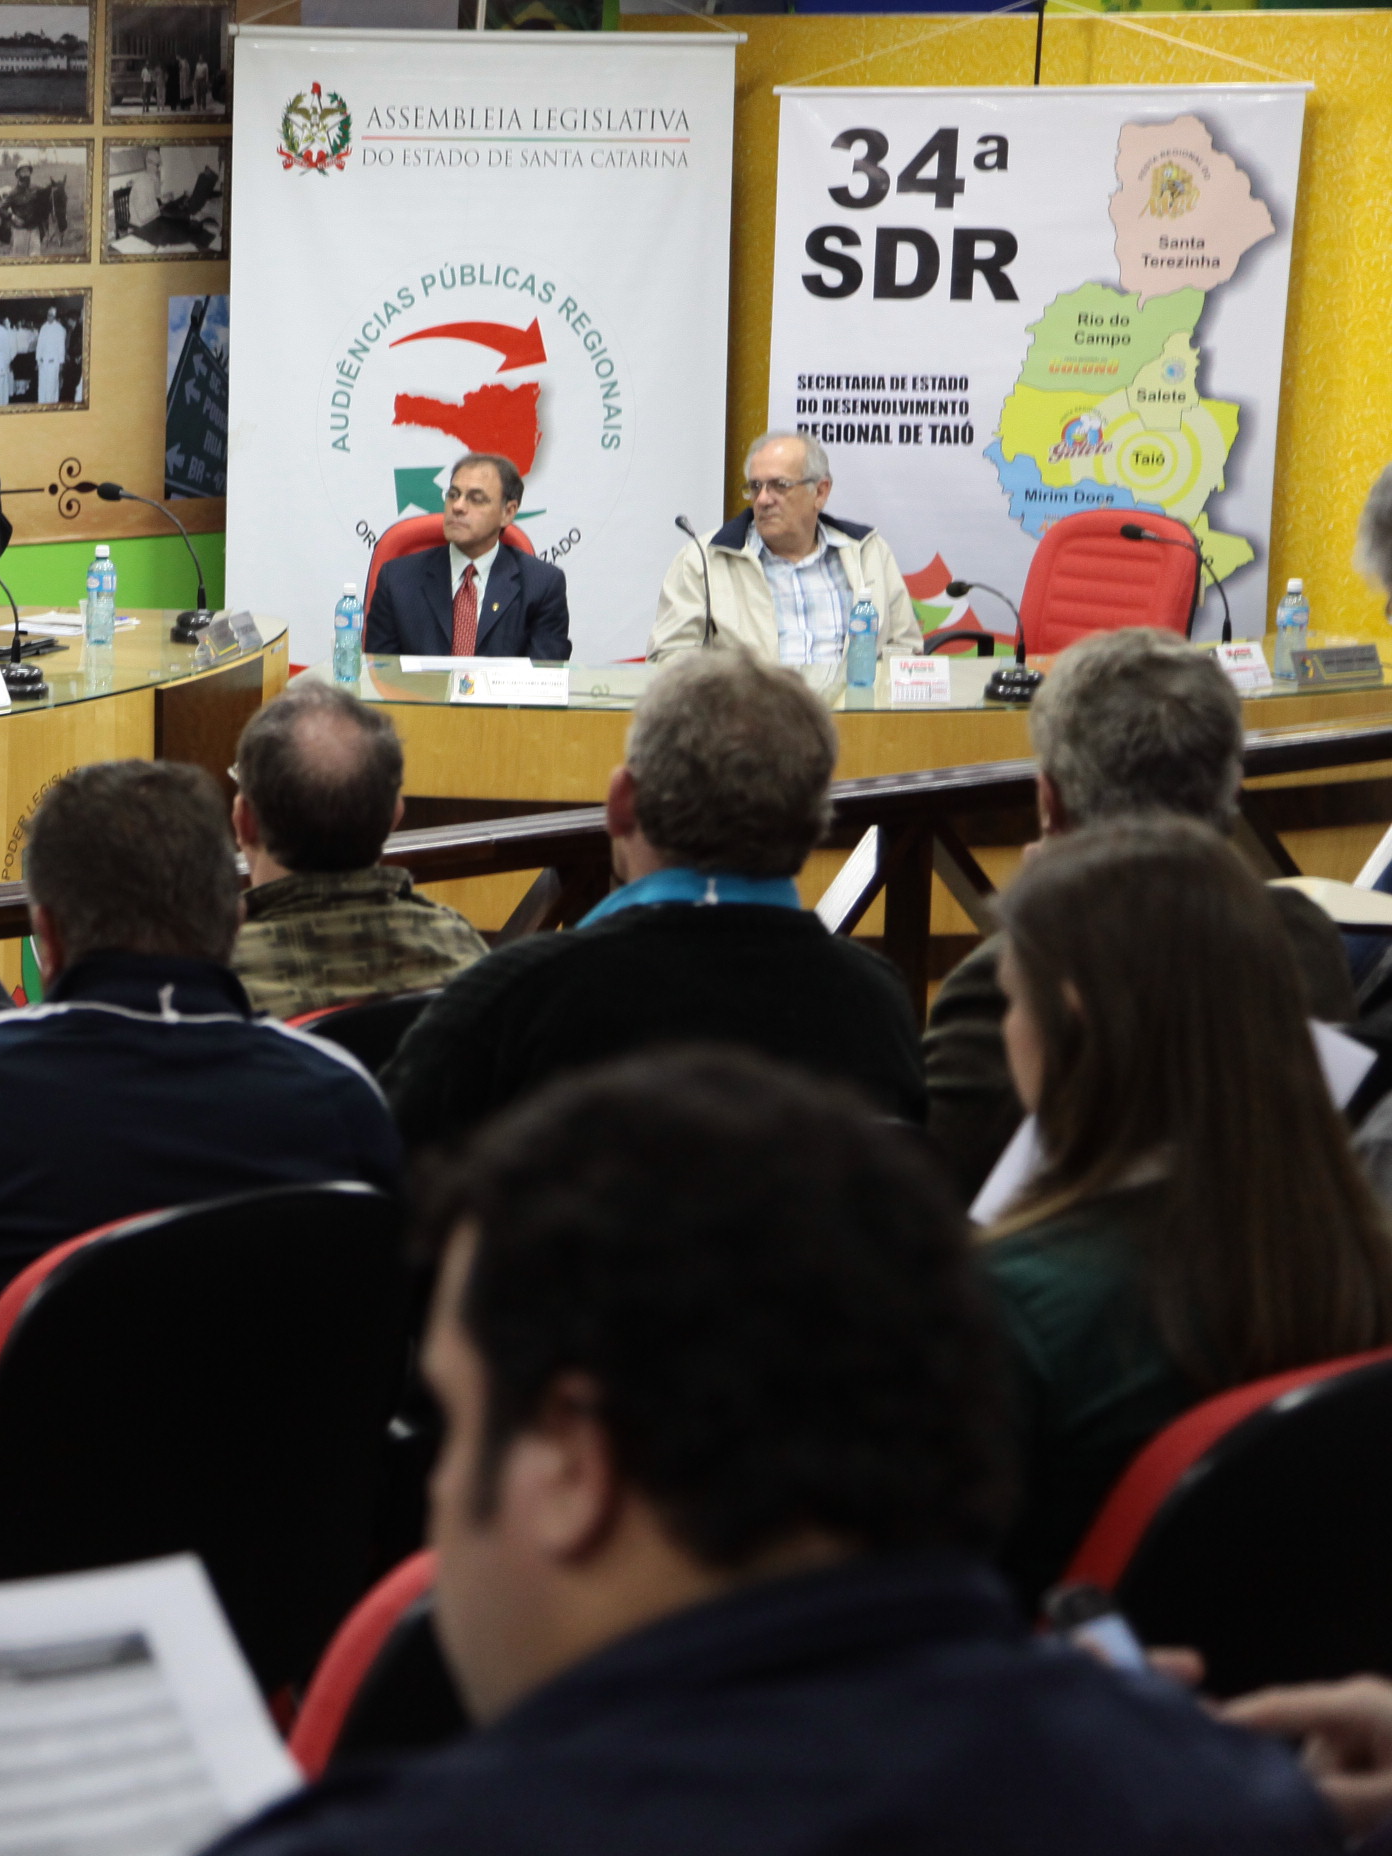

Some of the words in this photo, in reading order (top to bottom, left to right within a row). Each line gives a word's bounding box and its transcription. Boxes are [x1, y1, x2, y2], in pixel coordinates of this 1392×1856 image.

[367, 106, 522, 131] ASSEMBLEIA
[533, 107, 691, 132] LEGISLATIVA
[362, 148, 394, 167] DO
[403, 148, 480, 168] ESTADO
[488, 149, 514, 168] DE
[520, 149, 584, 168] SANTA
[591, 149, 689, 168] CATARINA
[1159, 235, 1205, 249] Santa
[801, 225, 1020, 302] SDR
[1143, 254, 1220, 269] Terezinha
[1077, 312, 1104, 326] Rio
[1109, 312, 1130, 326] do
[1074, 331, 1131, 347] Campo
[330, 287, 415, 453] AUDIÊNCIAS
[421, 262, 556, 304] PÚBLICAS
[557, 297, 623, 451] REGIONAIS
[797, 374, 886, 391] SECRETARIA
[889, 375, 908, 391] DE
[912, 375, 969, 392] ESTADO
[1137, 389, 1187, 403] Salete
[796, 398, 818, 414] DO
[822, 398, 970, 416] DESENVOLVIMENTO
[898, 423, 923, 445] DE
[928, 420, 975, 446] TAIÓ
[1134, 450, 1166, 466] Taió
[1024, 487, 1069, 503] Mirim
[1074, 489, 1115, 505] Doce
[1, 814, 26, 881] PODER
